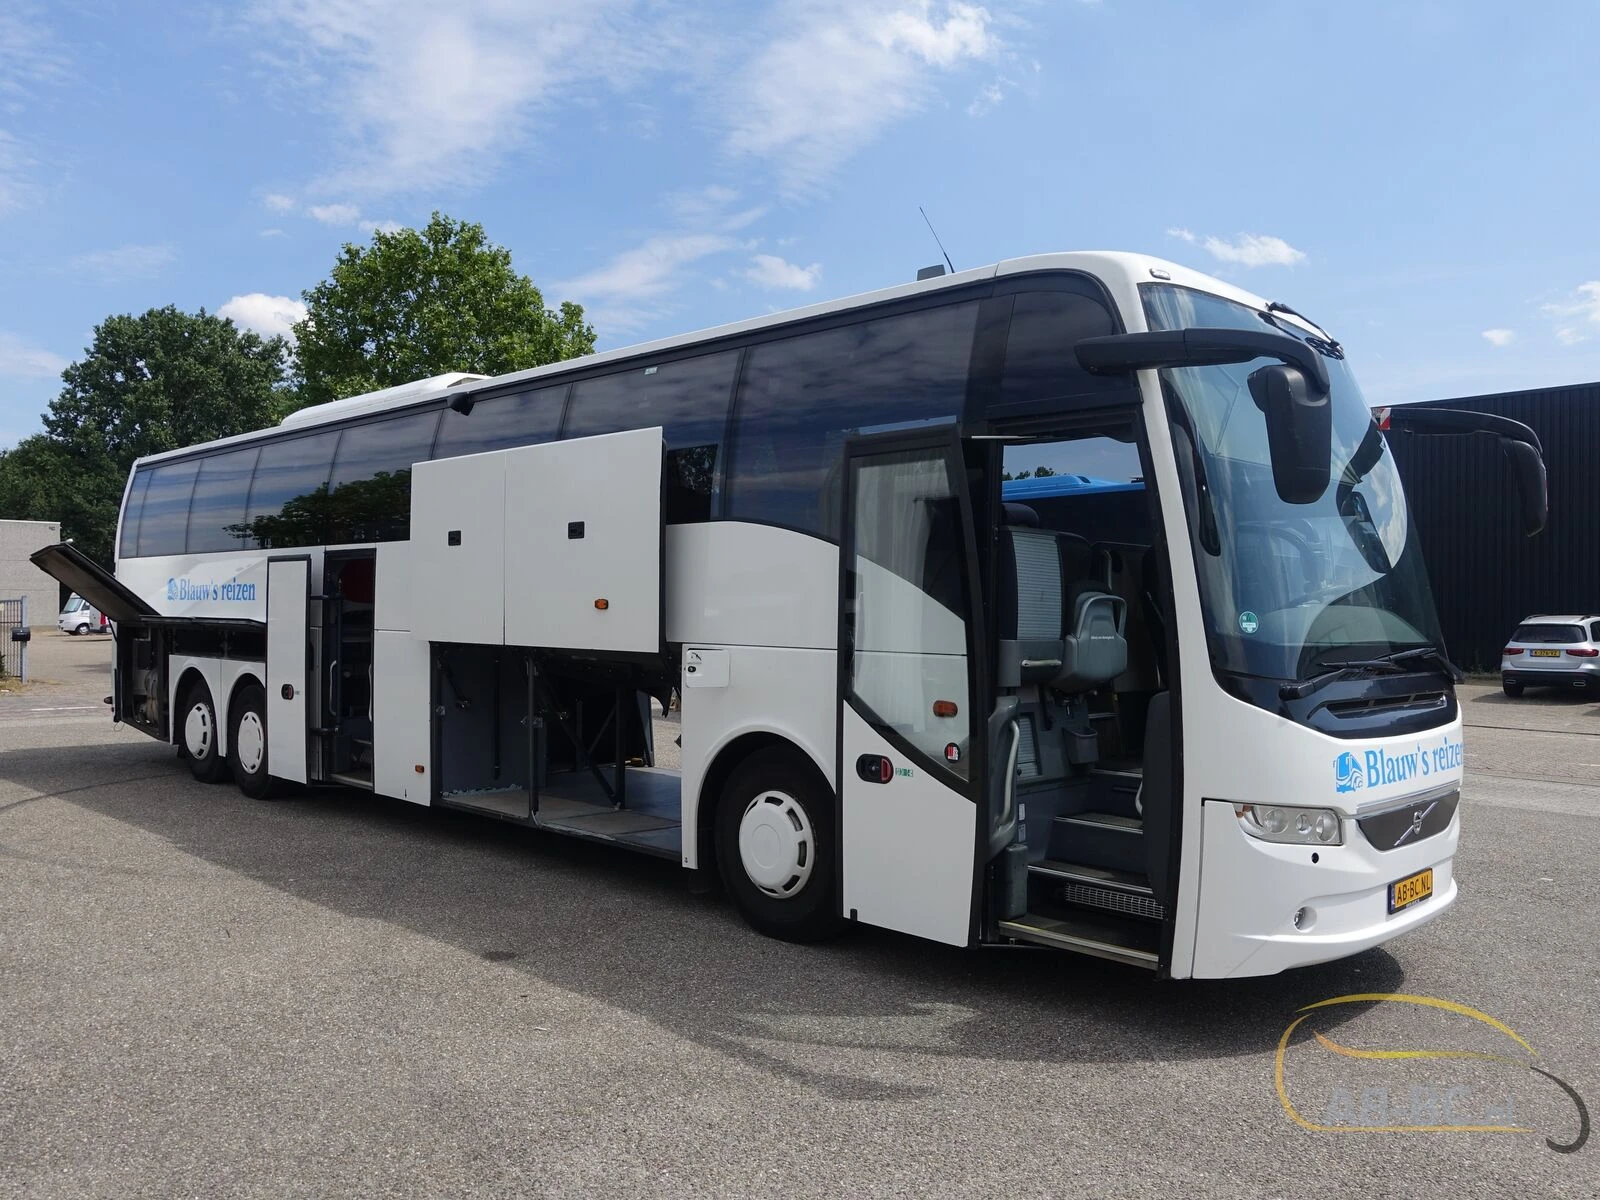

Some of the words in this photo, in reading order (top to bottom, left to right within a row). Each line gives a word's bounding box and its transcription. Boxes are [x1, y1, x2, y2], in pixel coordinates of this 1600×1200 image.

[179, 577, 218, 601] Blauw's
[221, 576, 256, 601] reizen
[1364, 742, 1429, 788] Blauw's
